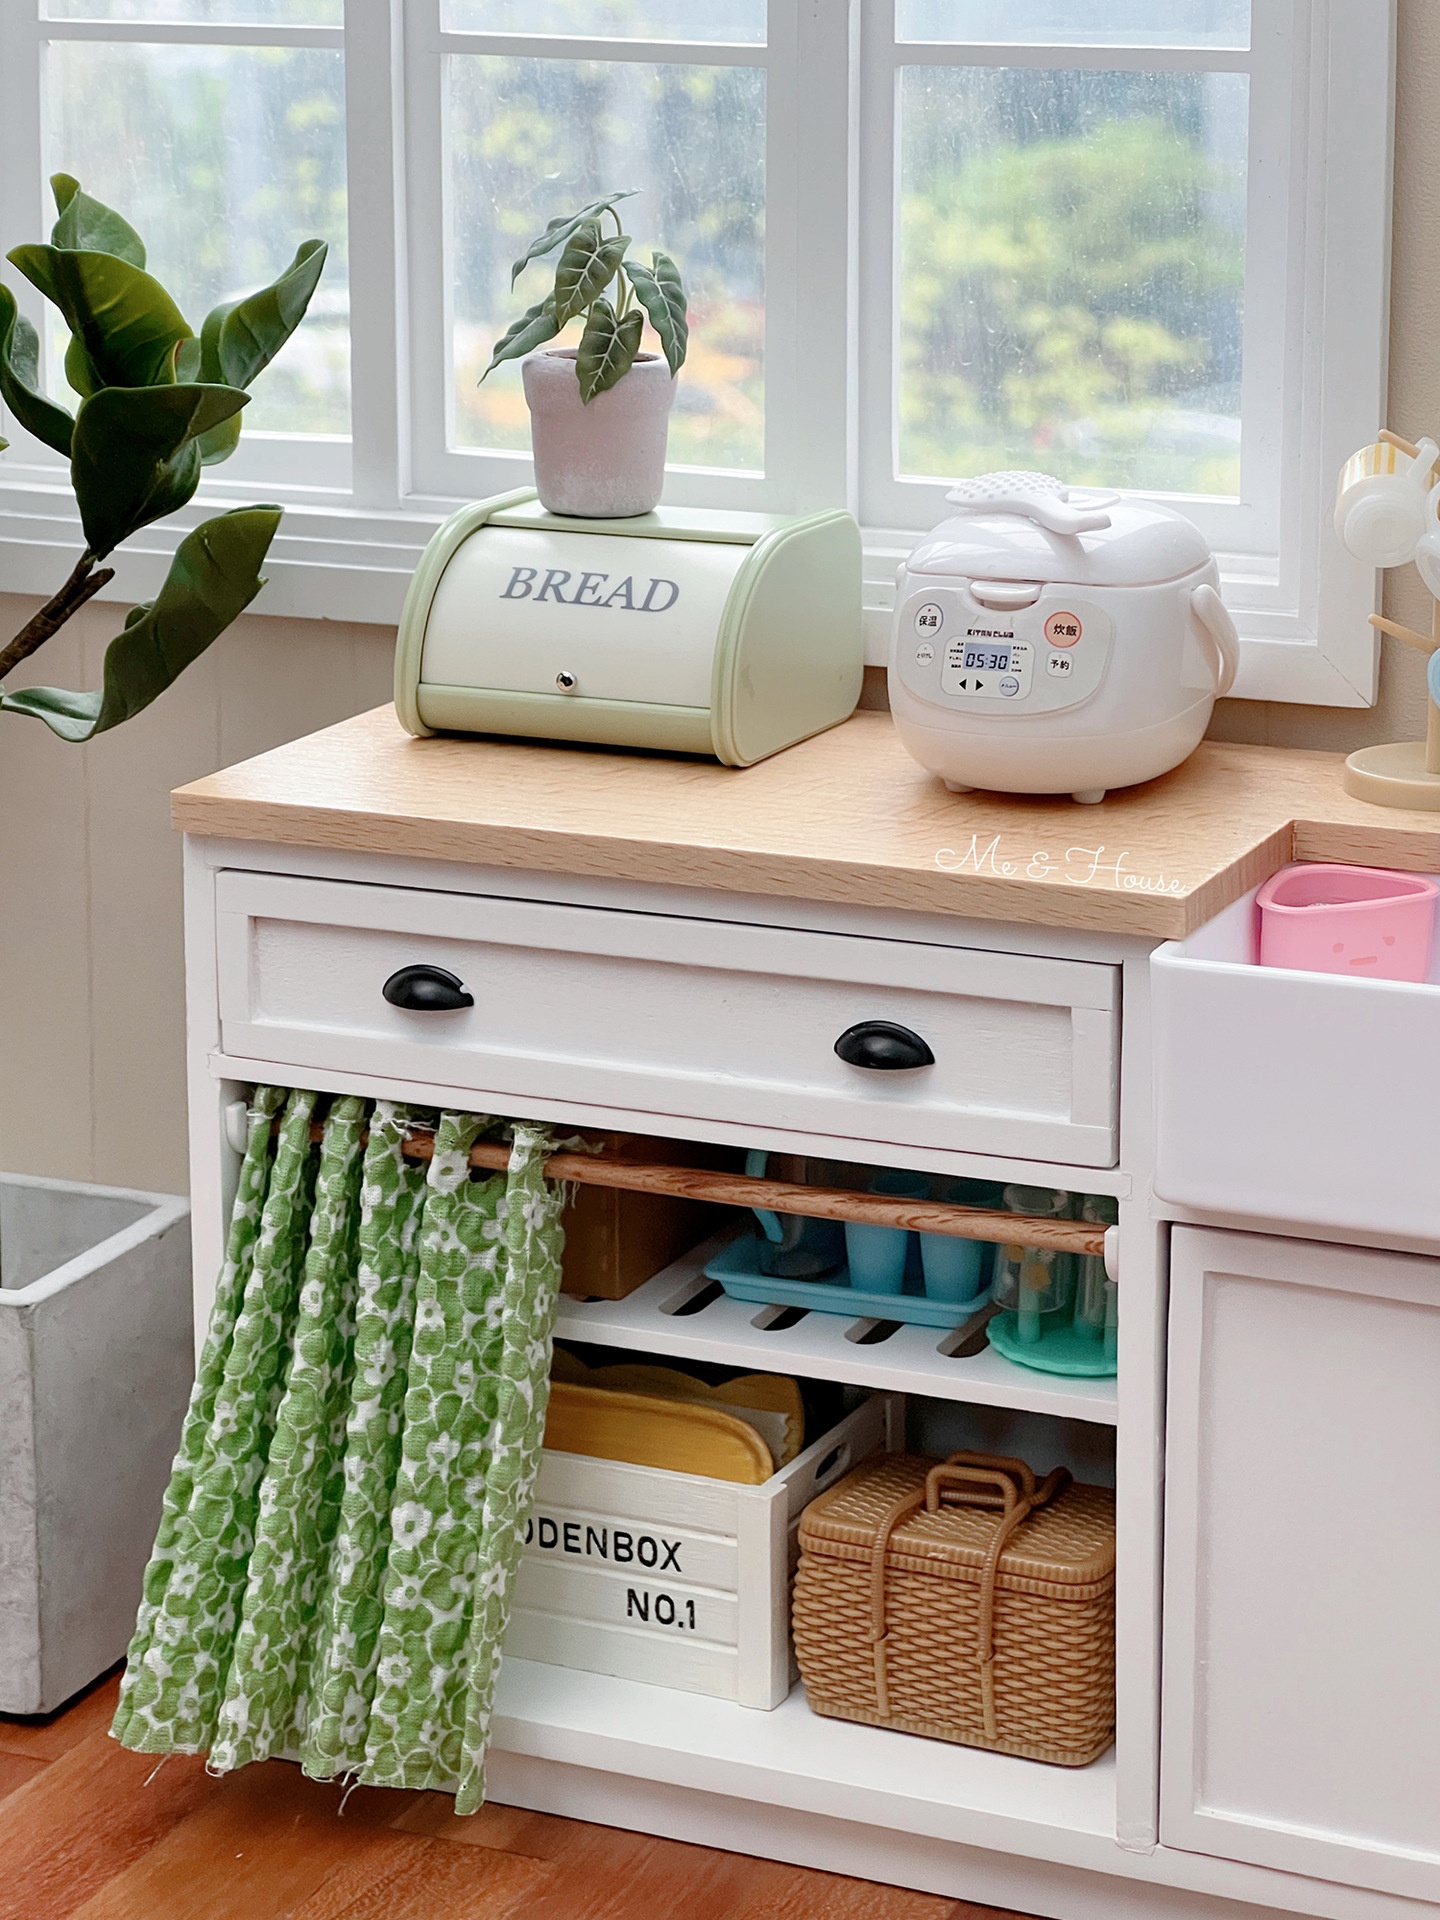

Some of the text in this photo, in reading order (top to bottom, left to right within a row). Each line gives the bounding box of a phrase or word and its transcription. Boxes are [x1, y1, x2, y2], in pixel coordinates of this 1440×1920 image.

[499, 566, 680, 613] BREAD
[918, 615, 937, 627] 保温
[1053, 623, 1077, 637] 炊飯
[965, 652, 1008, 670] 05:30
[1050, 660, 1070, 670] 予約
[627, 1588, 695, 1629] NO.1
